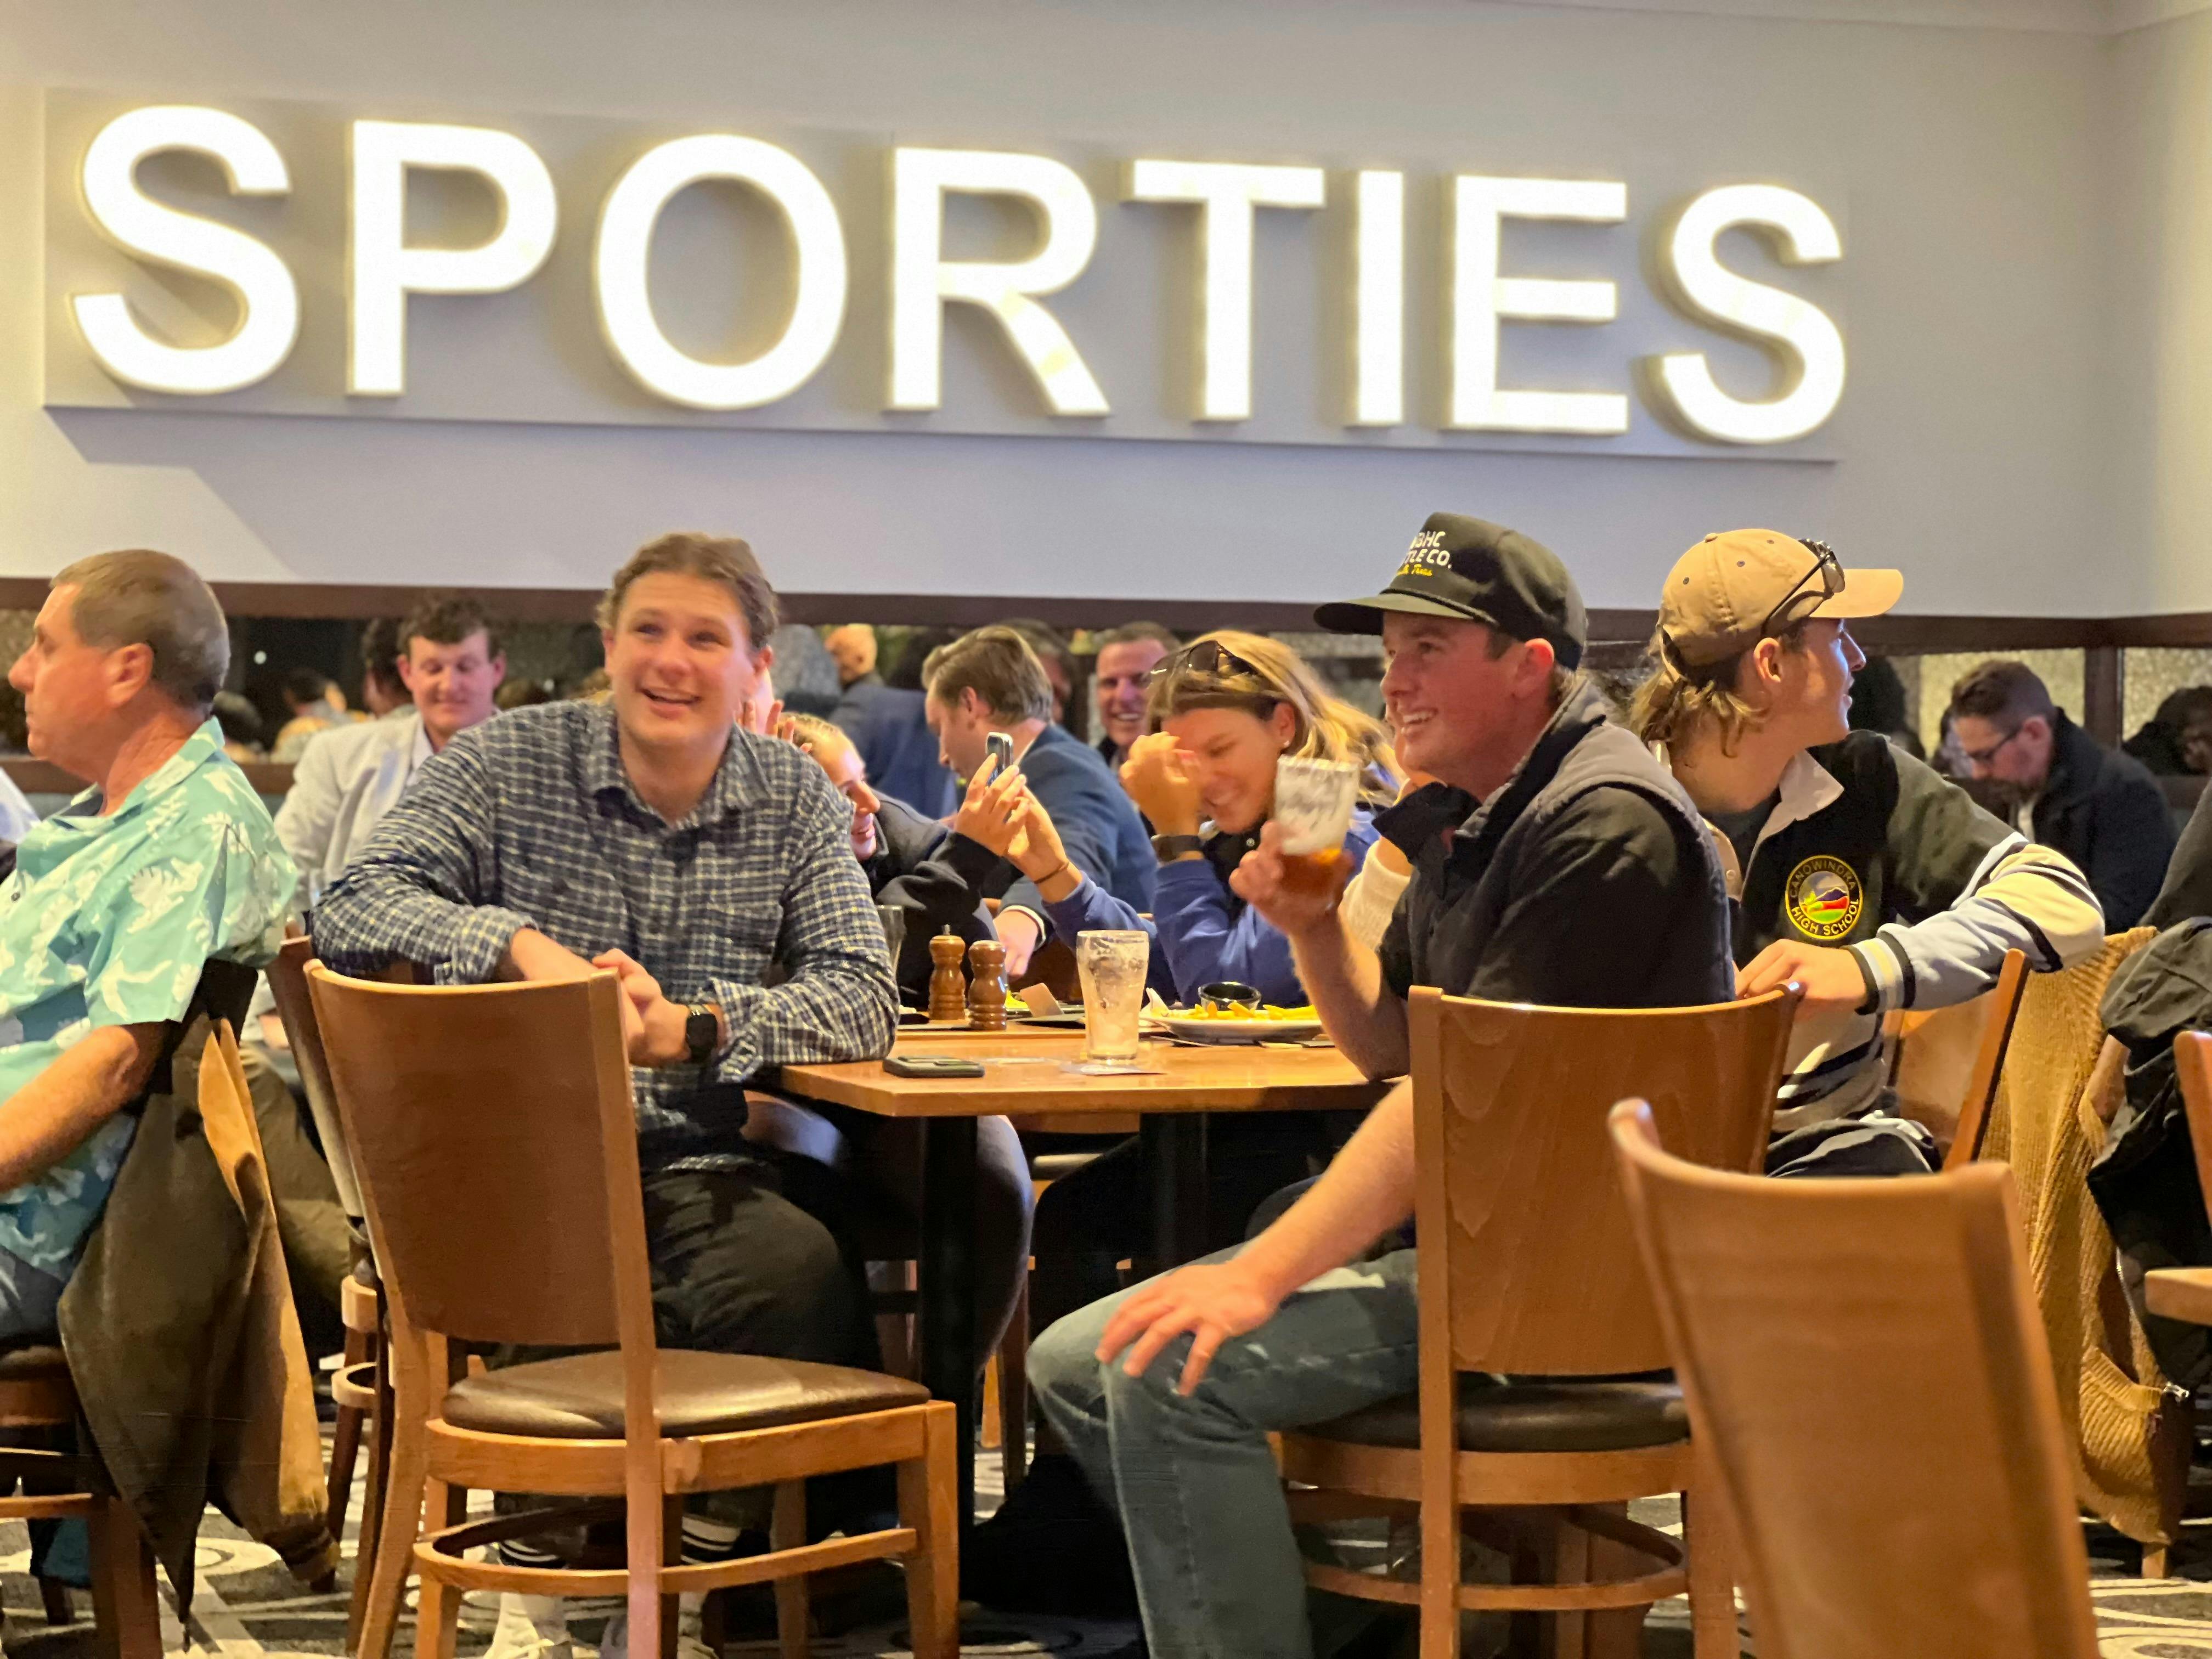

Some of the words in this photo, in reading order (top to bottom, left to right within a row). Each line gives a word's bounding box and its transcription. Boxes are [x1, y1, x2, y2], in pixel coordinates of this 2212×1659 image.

[72, 105, 1846, 444] SPORTIES
[1426, 549, 1452, 569] CO.
[1790, 860, 1857, 898] CANOWINDRA
[1791, 906, 1819, 934] HIGH
[1822, 899, 1859, 936] SCHOOL
